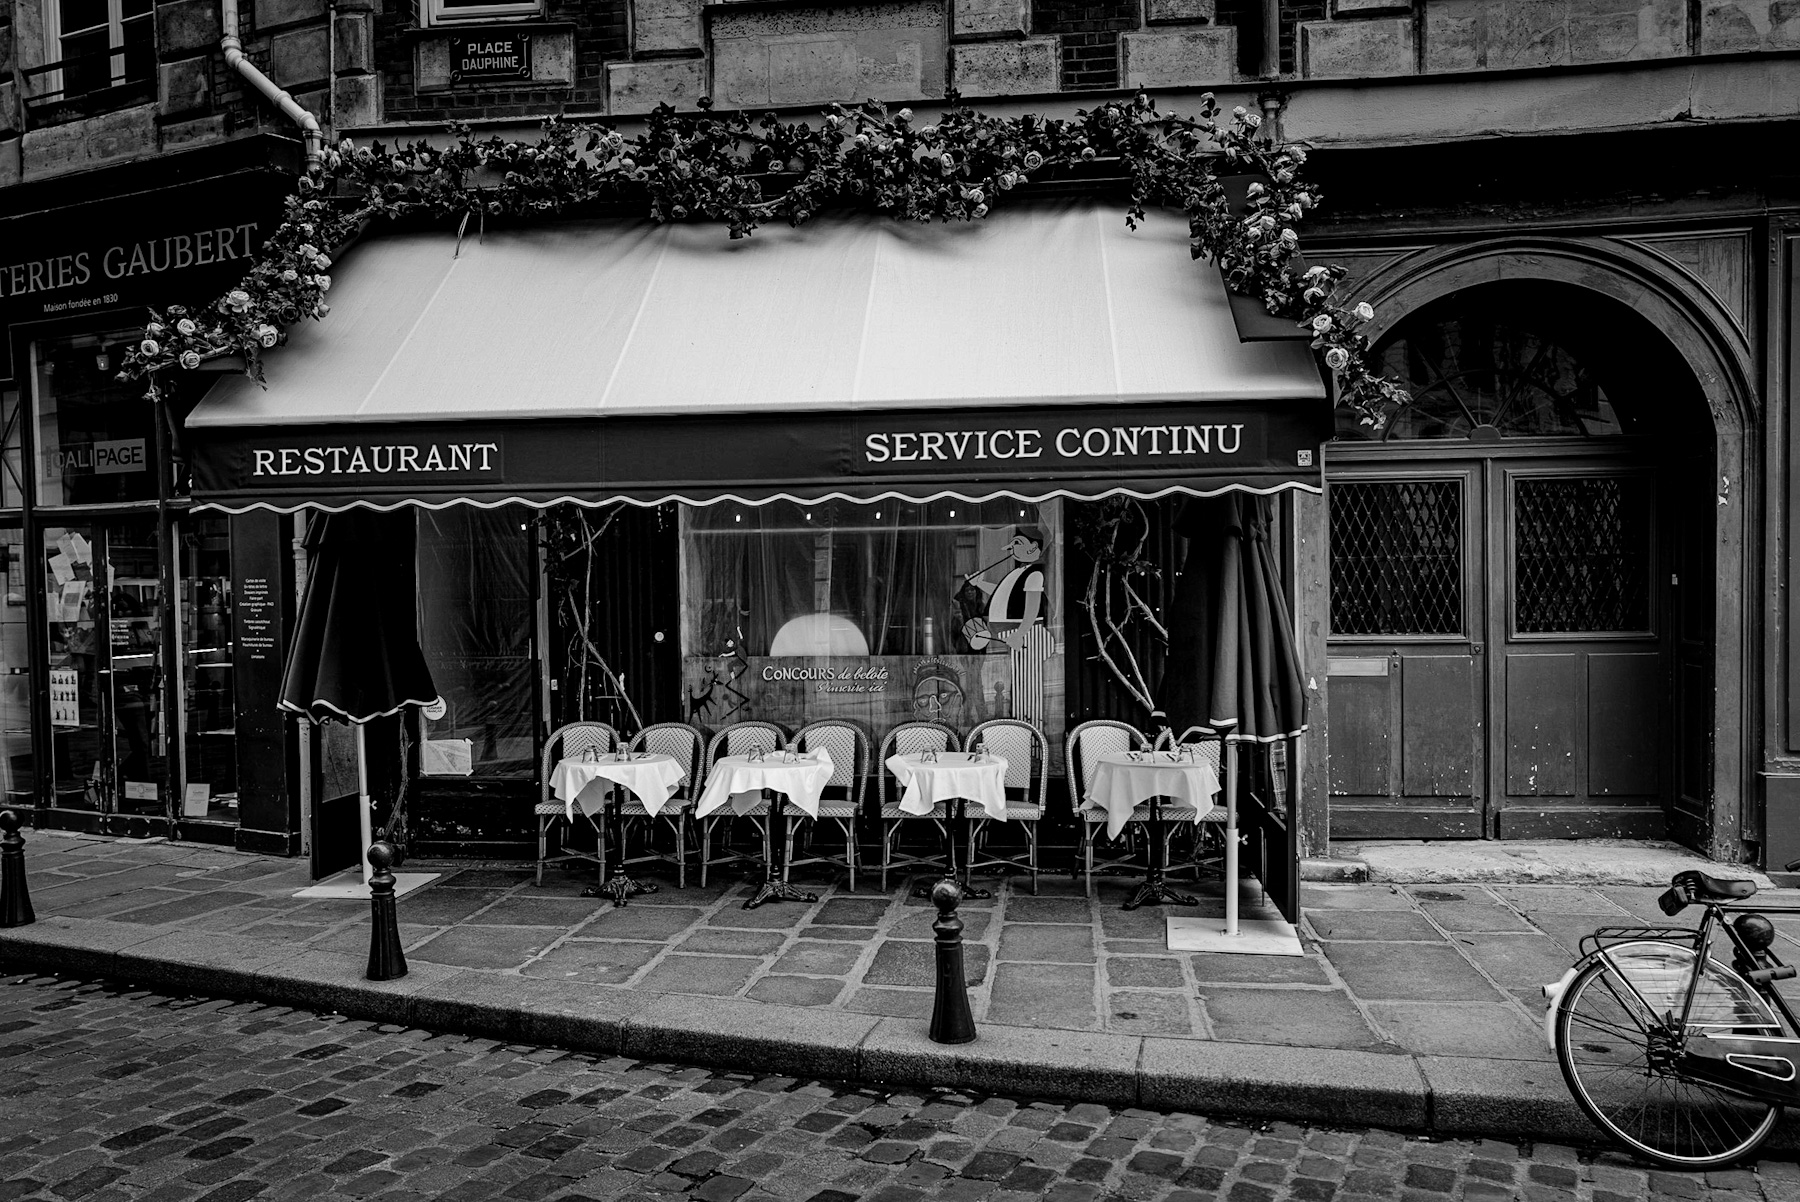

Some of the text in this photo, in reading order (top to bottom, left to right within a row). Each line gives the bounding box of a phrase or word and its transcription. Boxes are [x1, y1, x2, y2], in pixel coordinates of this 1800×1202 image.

[467, 41, 513, 55] PLACE
[462, 56, 519, 71] DAUPHINE
[103, 222, 258, 279] GAUBERT
[43, 293, 118, 313] Maison fondée en 1830
[252, 423, 1245, 476] RESTAURANT SERVICE CONTINU
[837, 666, 852, 681] de
[853, 666, 889, 680] belote
[868, 681, 888, 693] ici
